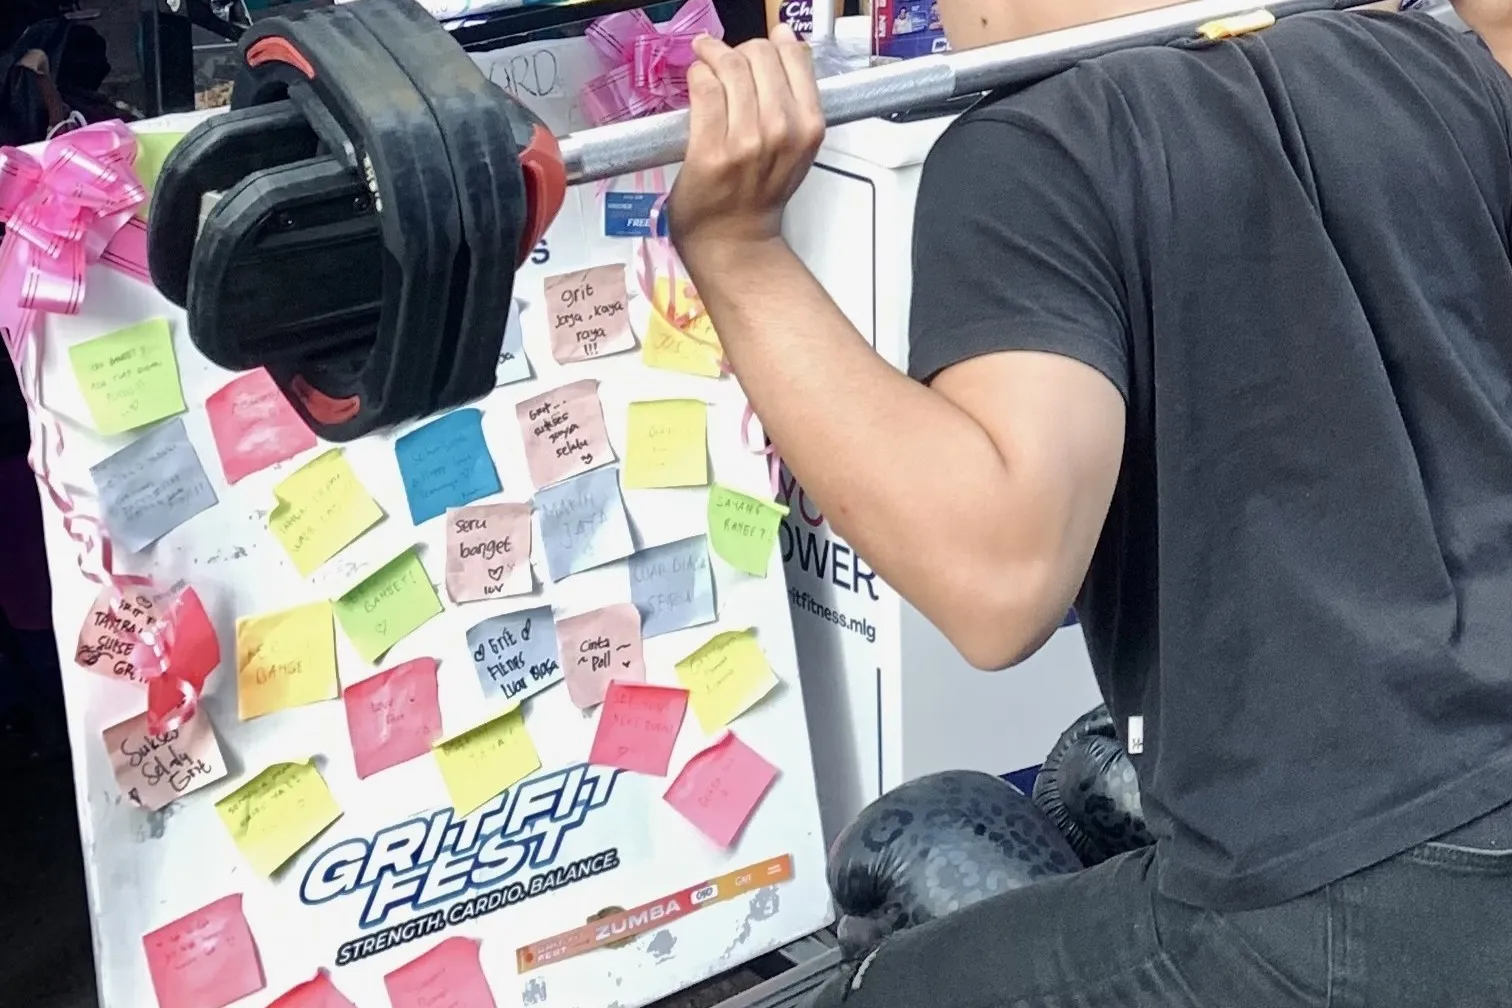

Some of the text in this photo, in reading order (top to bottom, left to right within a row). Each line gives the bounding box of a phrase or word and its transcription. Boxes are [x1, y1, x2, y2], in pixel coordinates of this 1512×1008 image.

[459, 536, 513, 560] banget
[300, 788, 511, 906] GRIT
[500, 763, 629, 839] FIT
[357, 802, 588, 930] FEST
[336, 846, 621, 968] STRENGTH. CARDIO. BALANCE.
[595, 899, 681, 942] ZUMBA
